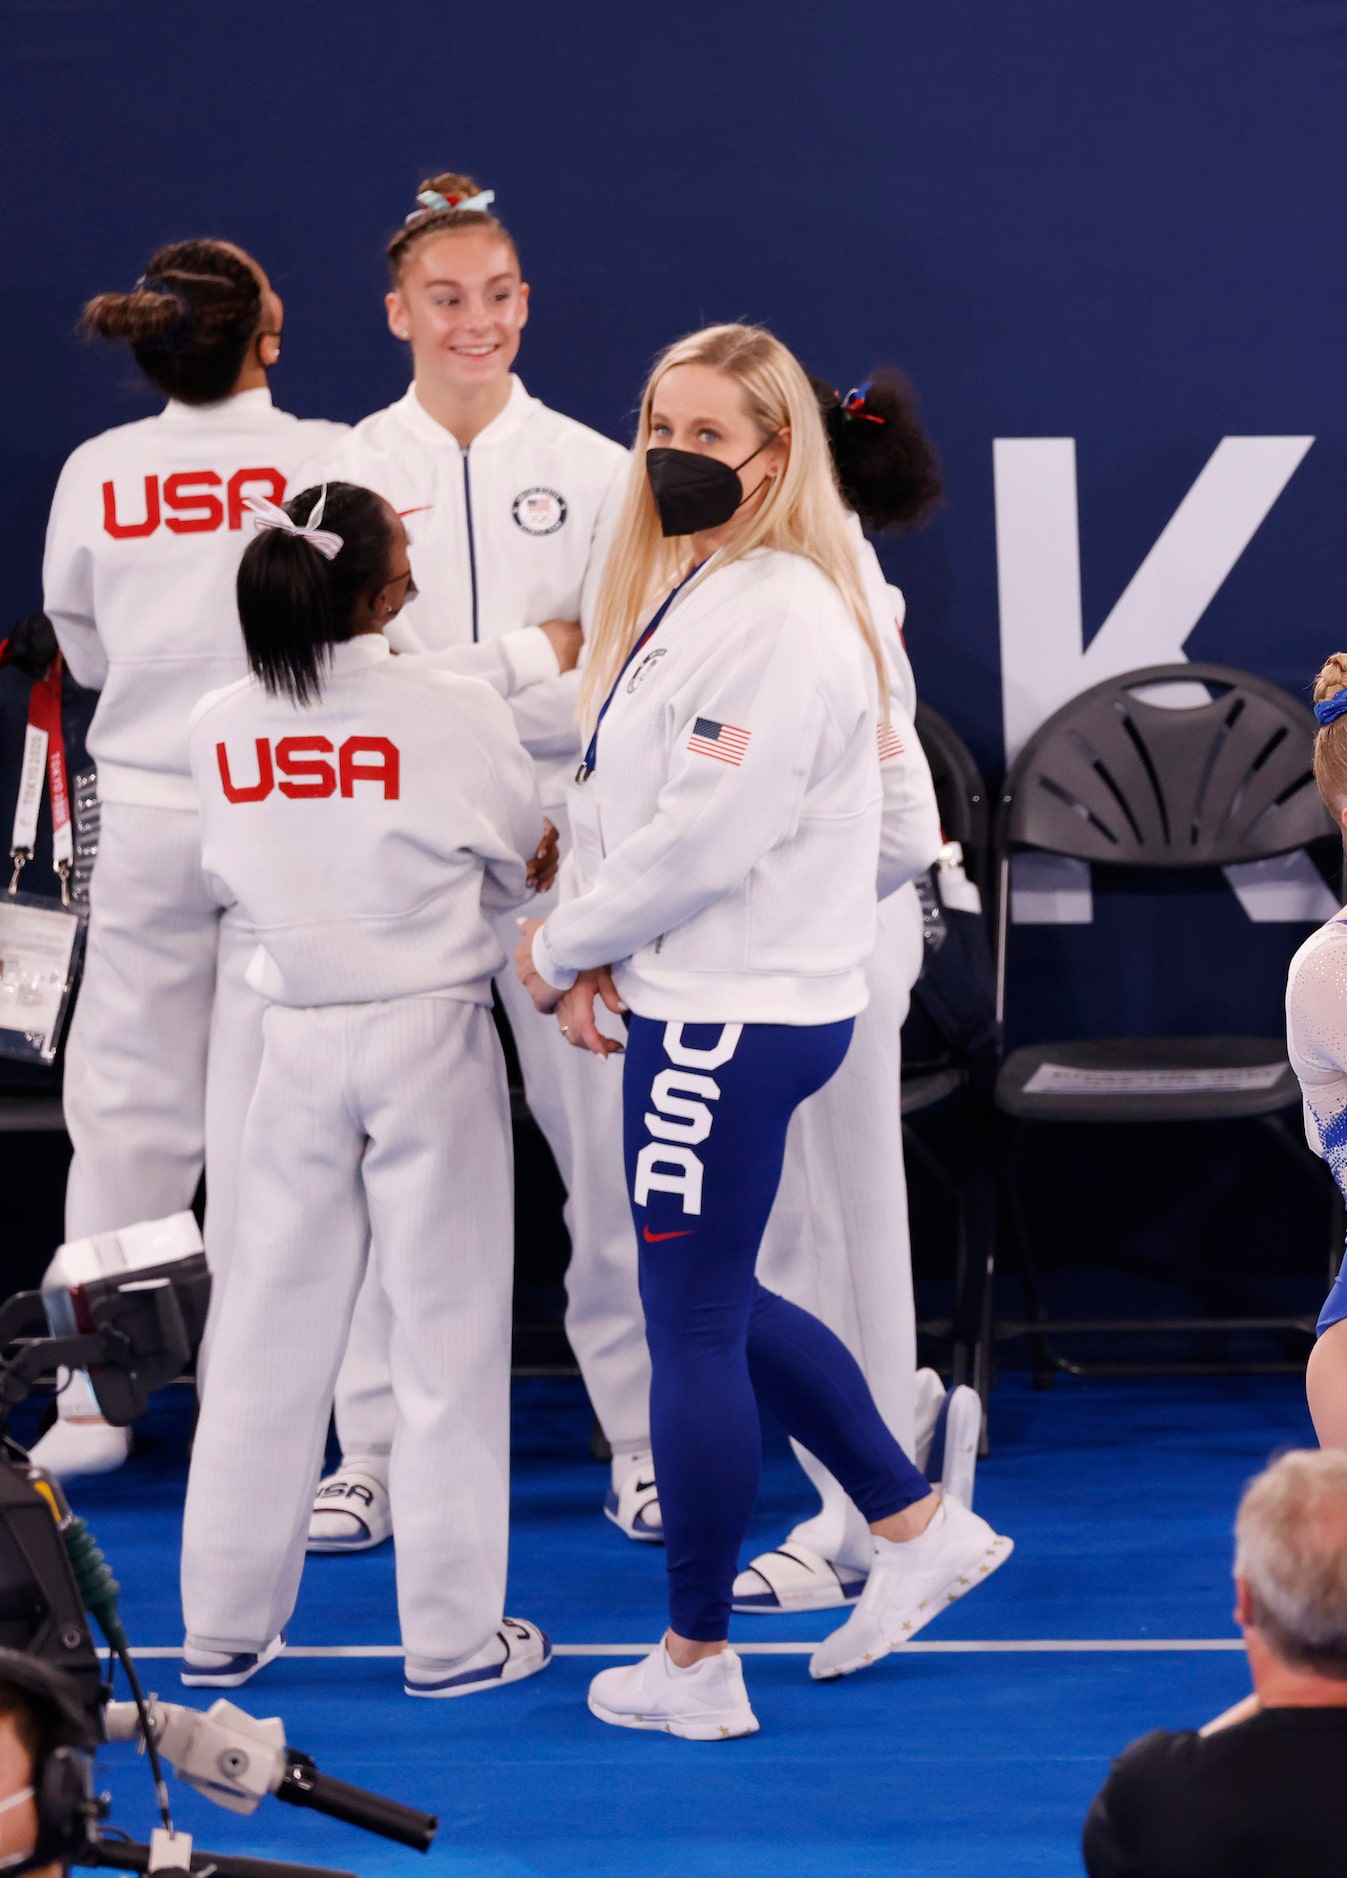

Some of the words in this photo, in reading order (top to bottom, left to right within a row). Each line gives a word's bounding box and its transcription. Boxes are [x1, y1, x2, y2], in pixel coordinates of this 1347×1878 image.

[102, 467, 287, 541] USA
[216, 735, 400, 804] USA
[633, 1020, 744, 1216] USA
[316, 1482, 374, 1508] SA
